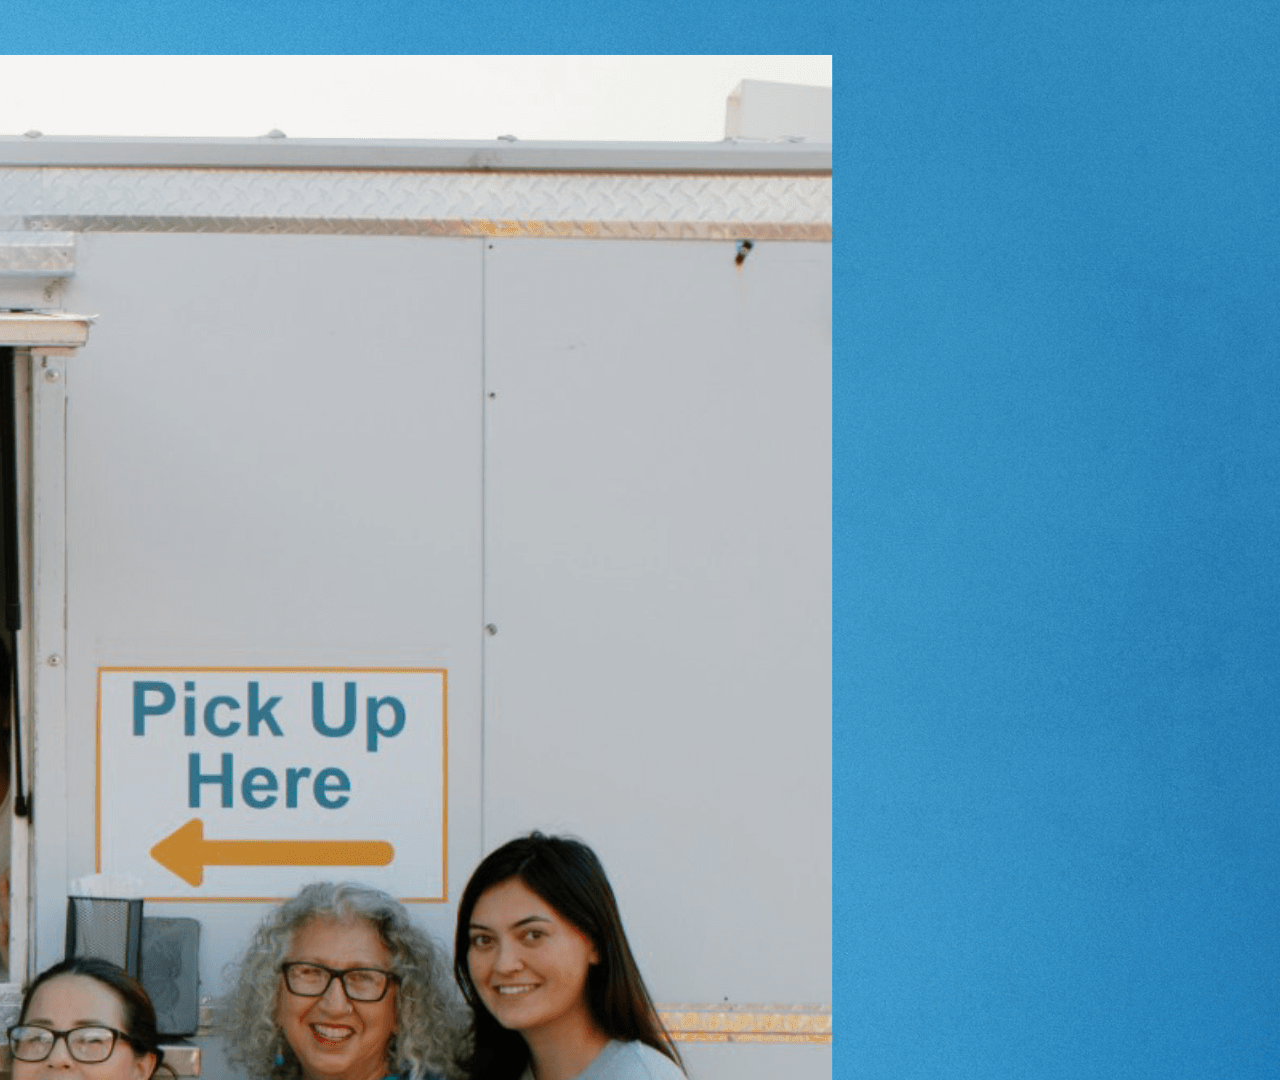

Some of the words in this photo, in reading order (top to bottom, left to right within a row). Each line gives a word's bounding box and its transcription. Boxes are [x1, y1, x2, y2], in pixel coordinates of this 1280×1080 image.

[132, 681, 284, 737] Pick
[312, 682, 406, 752] Up
[187, 752, 351, 809] Here
